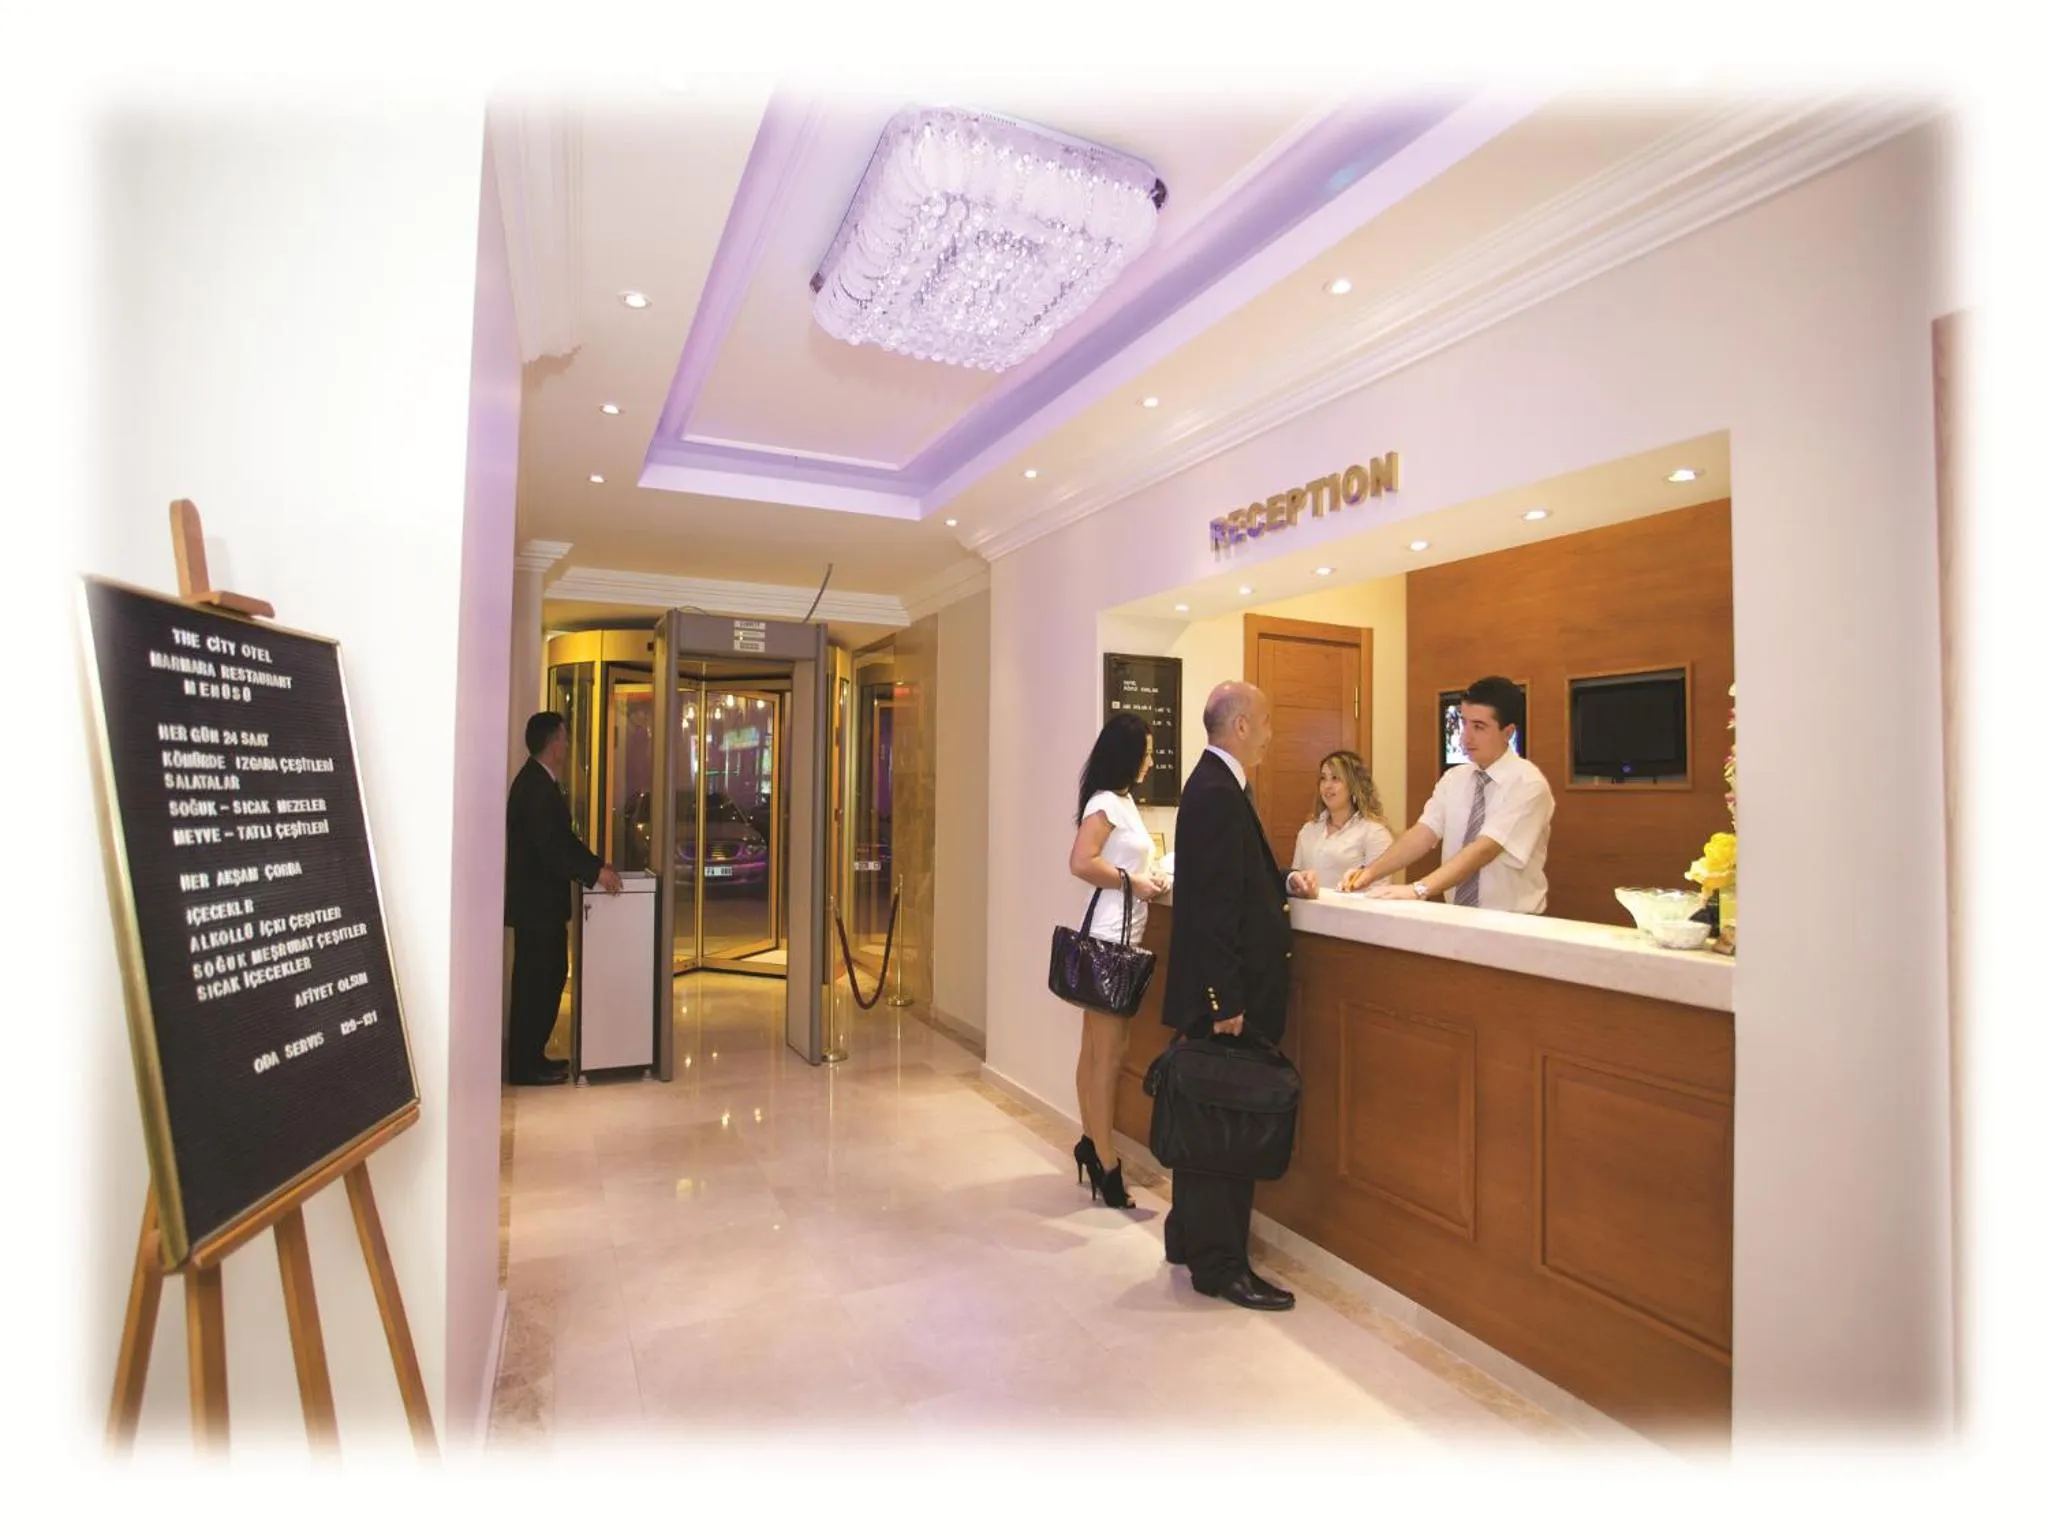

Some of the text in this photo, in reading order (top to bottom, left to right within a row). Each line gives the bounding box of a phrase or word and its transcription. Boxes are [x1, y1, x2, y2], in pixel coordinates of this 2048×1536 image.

[1209, 450, 1398, 553] RECEPTION
[172, 628, 200, 648] THE
[242, 644, 273, 663] OTEL
[150, 650, 292, 689] MARMARA RESTAURANT
[158, 724, 269, 747] HER GÜN 24 SAAT
[164, 773, 241, 790] SALATALAR
[169, 798, 217, 816] SOĞUK
[232, 799, 271, 815] SICAK
[277, 798, 327, 814] MEZELER
[172, 827, 221, 846] MEYVE
[237, 824, 272, 840] TATLI
[180, 873, 209, 892] HER
[265, 862, 302, 881] ÇORBA
[196, 975, 241, 1002] SICAK
[337, 972, 369, 992] OLSUN
[253, 1051, 280, 1075] ODA
